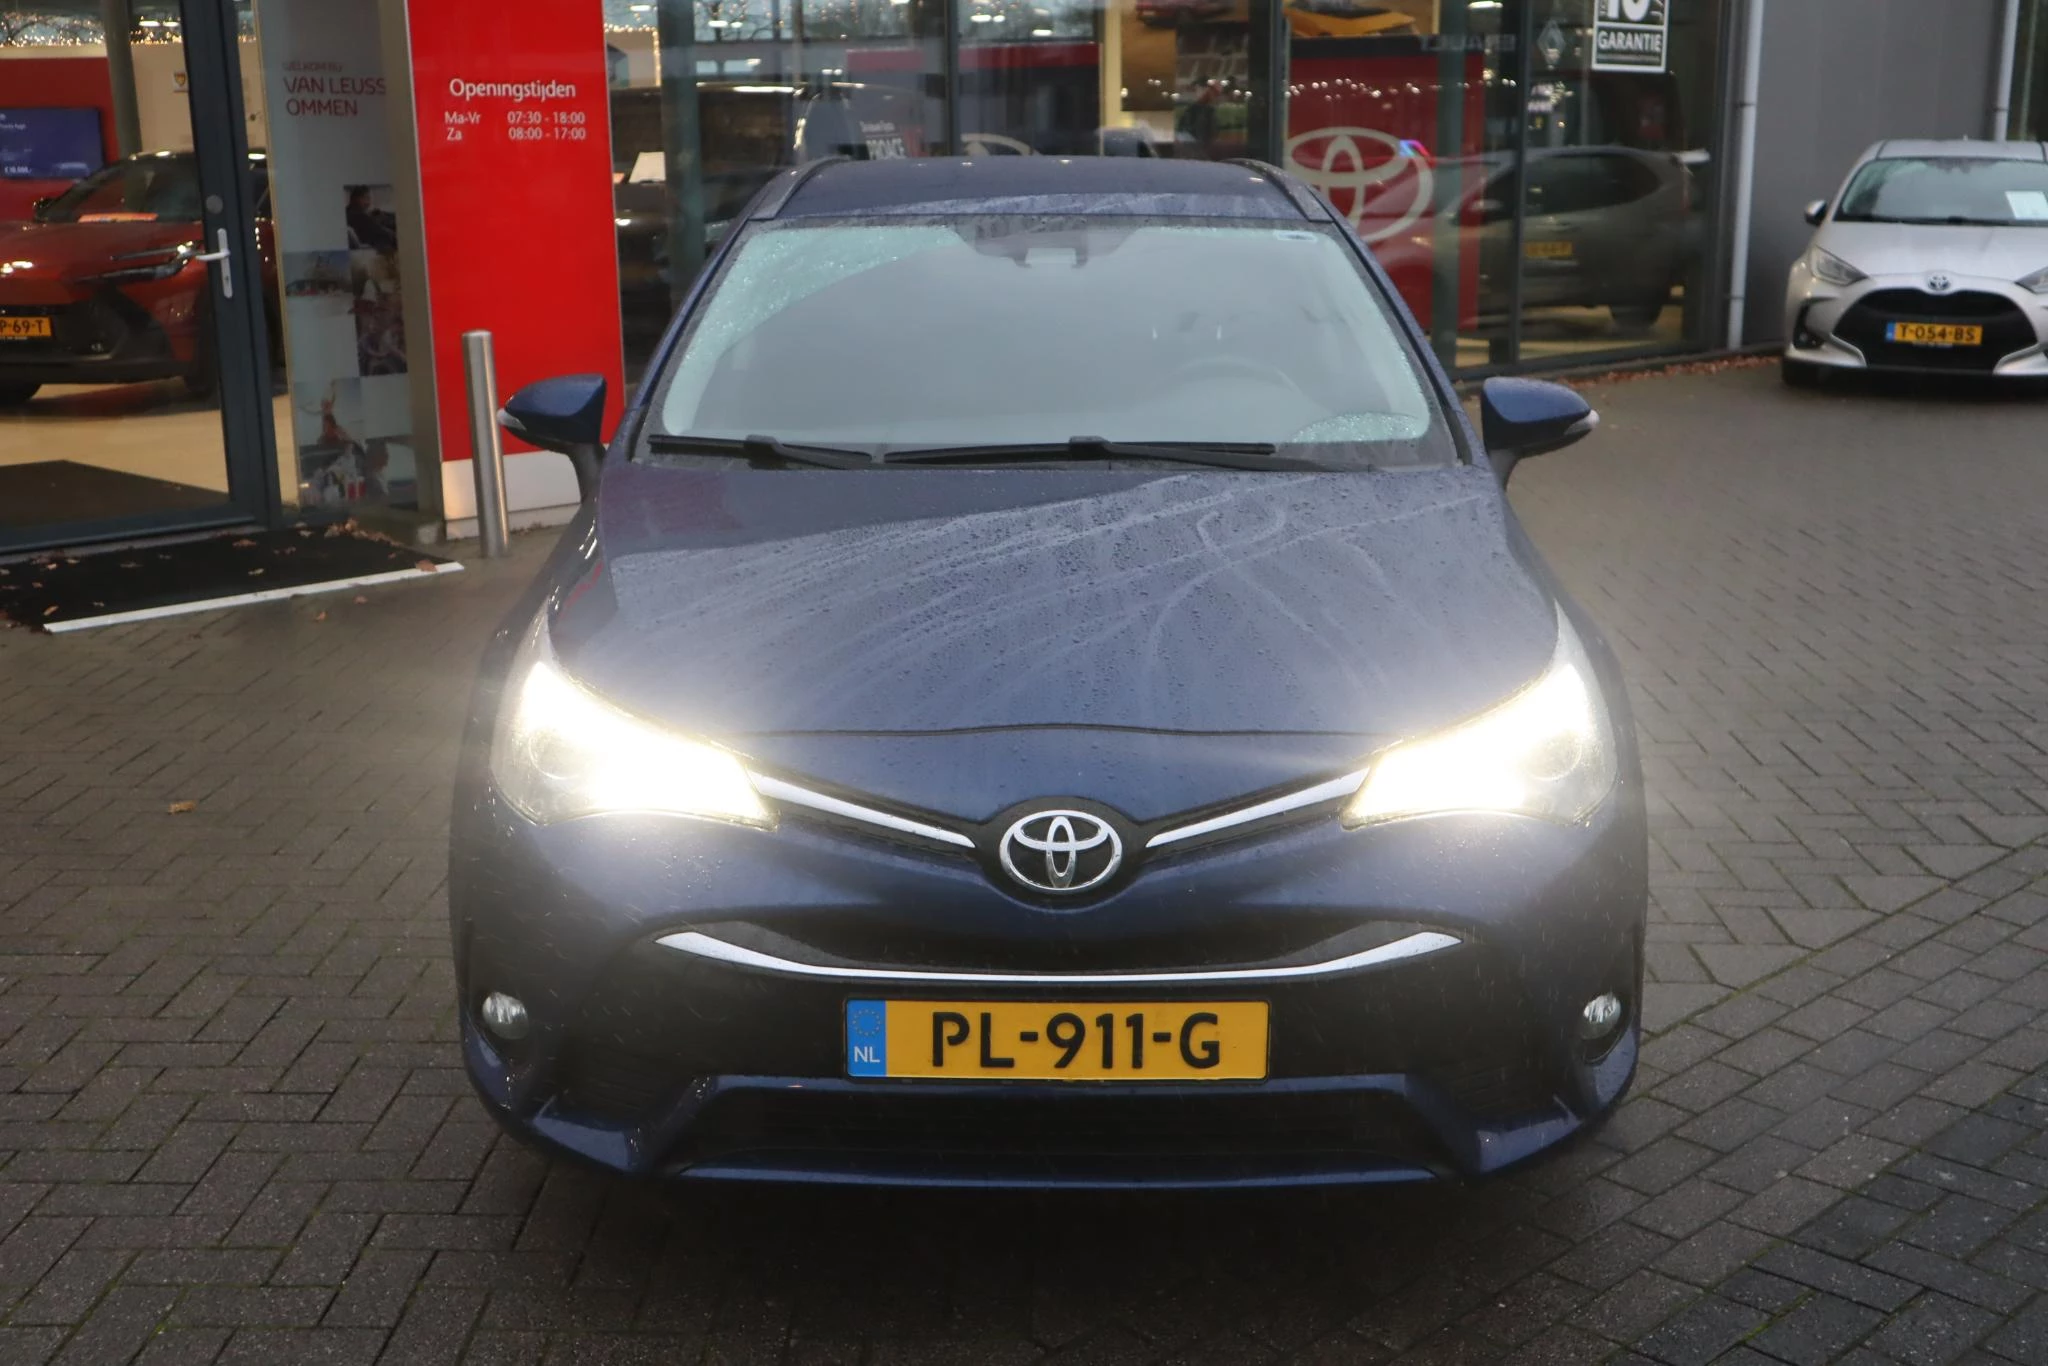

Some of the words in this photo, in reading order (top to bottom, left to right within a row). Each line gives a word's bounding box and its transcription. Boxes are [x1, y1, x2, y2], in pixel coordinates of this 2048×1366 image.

[1597, 30, 1662, 52] GARANTIE
[283, 76, 324, 94] VAN
[329, 77, 387, 95] LEUSS
[449, 78, 576, 103] Openingstijden
[286, 98, 358, 116] OMMEN
[445, 111, 481, 125] Ma-Vr
[507, 111, 541, 124] 07:30
[553, 111, 586, 124] 18:00
[447, 127, 463, 141] Za
[508, 127, 543, 140] 08:00
[554, 127, 587, 140] 17:00
[1899, 324, 1975, 341] T-054-BS
[932, 1011, 1221, 1069] PL-911-G
[853, 1046, 881, 1064] NL
